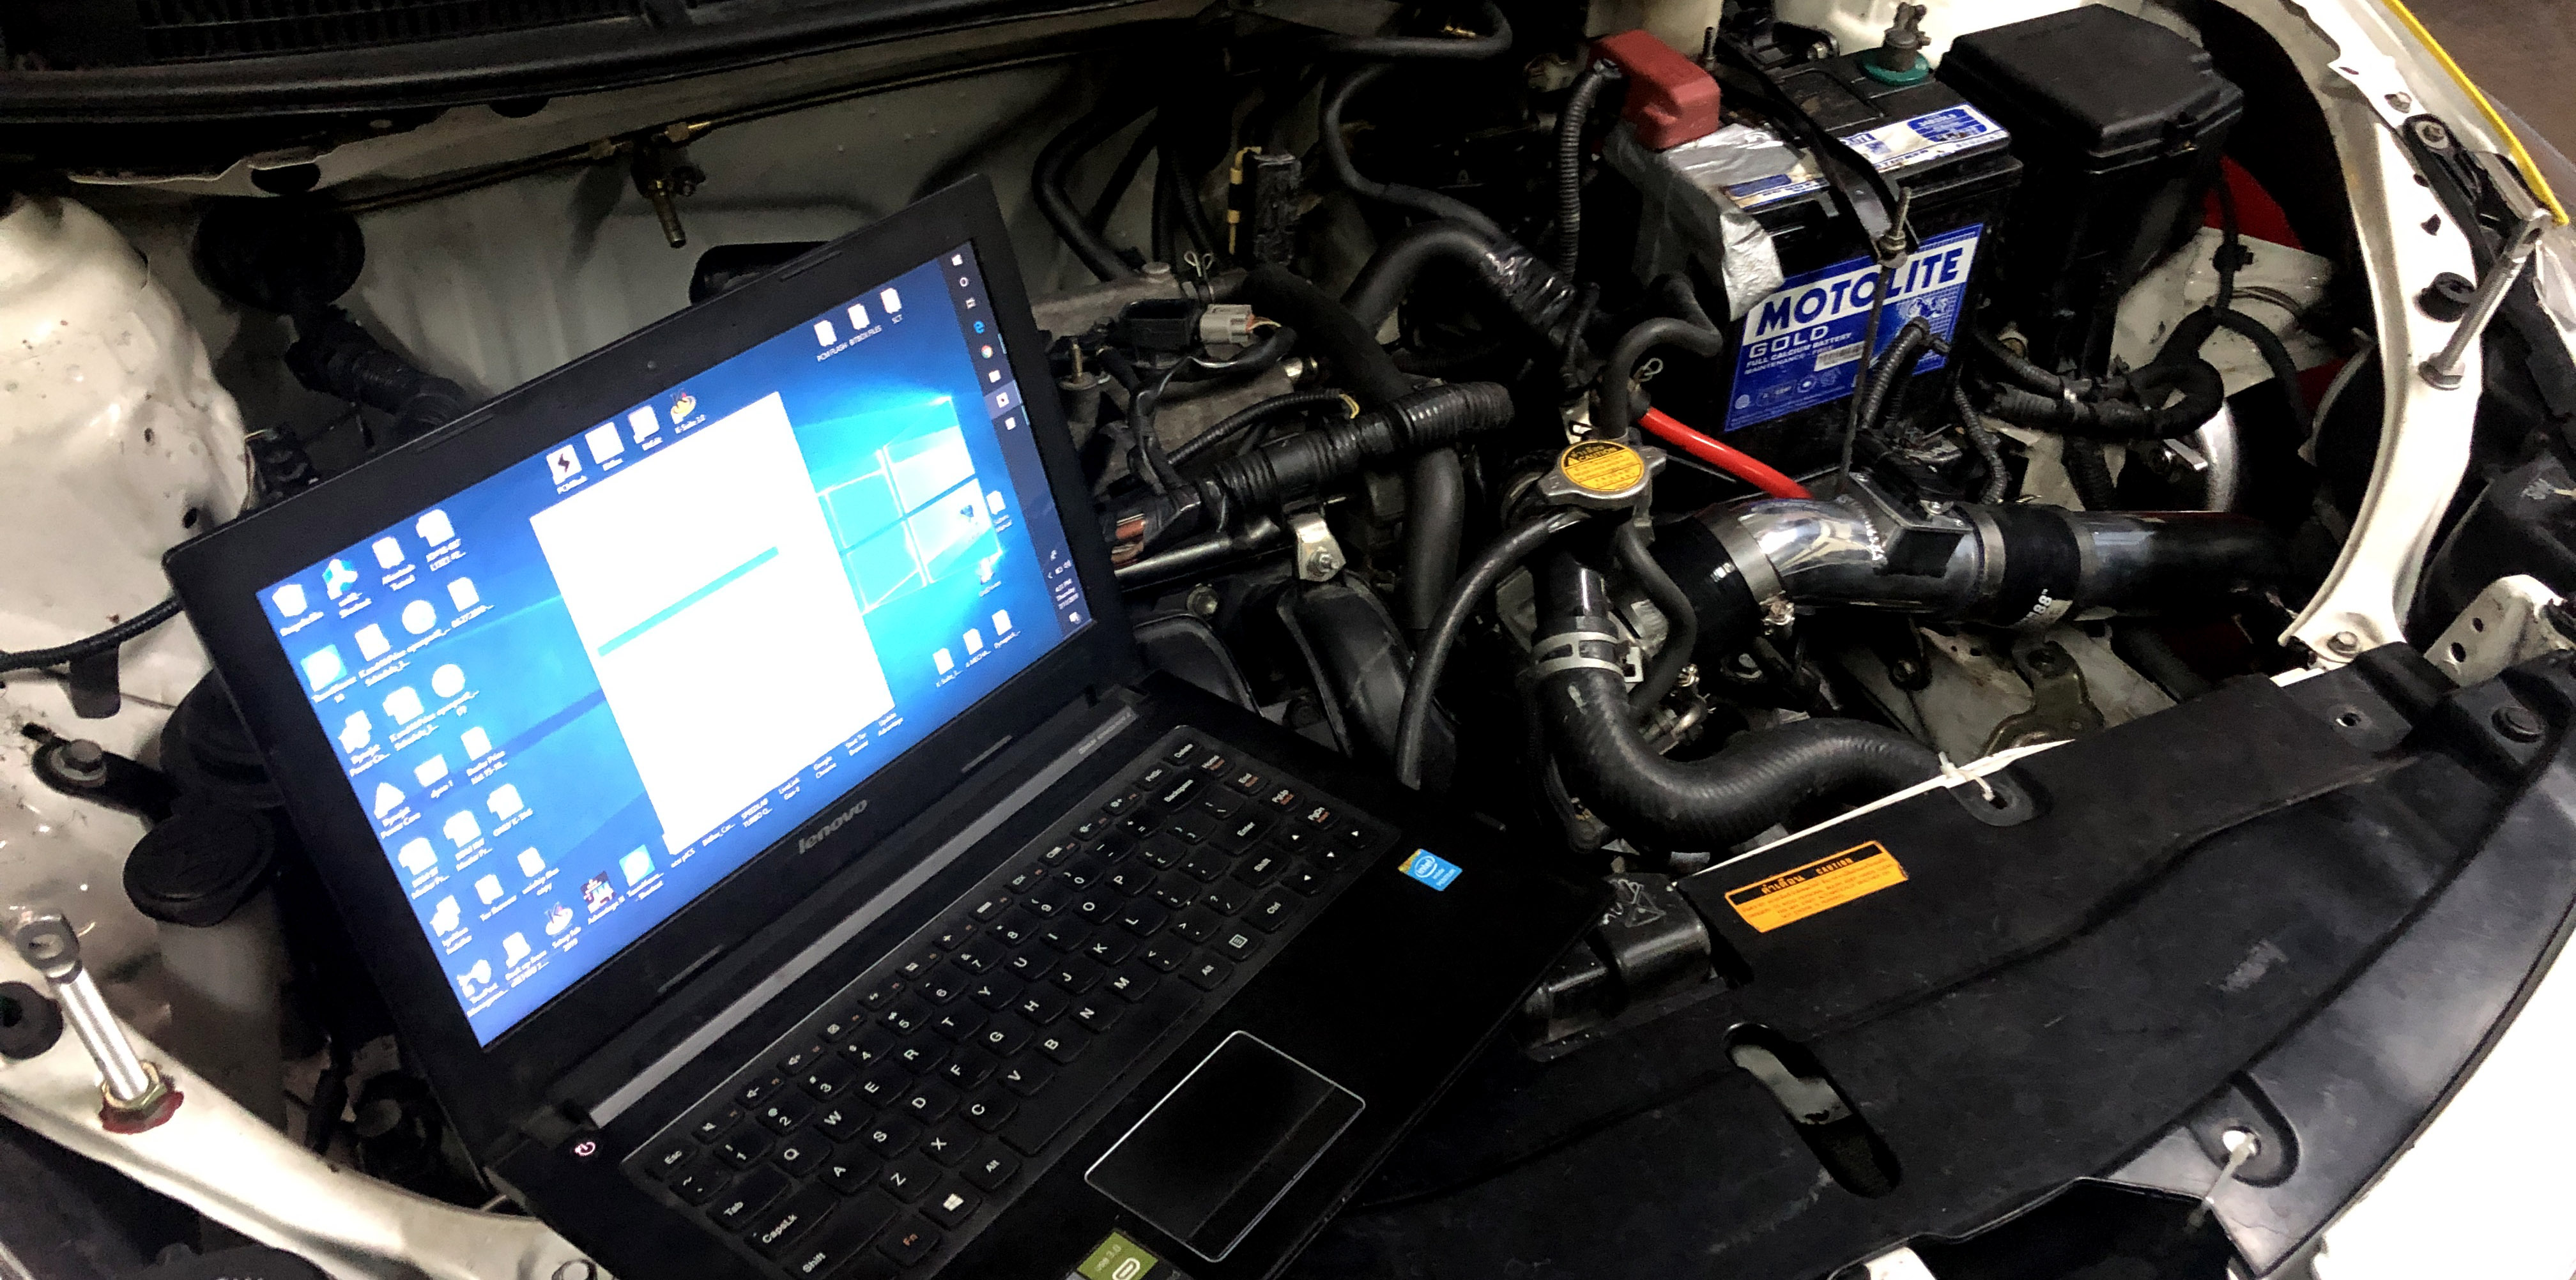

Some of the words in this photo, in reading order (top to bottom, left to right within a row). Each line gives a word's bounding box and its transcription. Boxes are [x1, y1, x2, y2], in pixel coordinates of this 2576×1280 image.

[1755, 247, 1963, 337] MOTOLITE
[1749, 325, 1829, 359] GOLD
[1747, 356, 1770, 369] FULL
[1770, 345, 1812, 362] CALCIUM
[1812, 332, 1852, 351] BATTERY
[1744, 354, 1807, 375] MAINTENANCE
[1578, 446, 1618, 462] CAUTION
[1174, 744, 1192, 758] Delete
[1165, 780, 1193, 802] Backspace
[799, 800, 869, 855] lenovo
[1238, 822, 1254, 835] Enter
[1254, 858, 1271, 871] Shift
[1815, 858, 1854, 876] CAUTION
[1114, 876, 1123, 884] P
[1083, 903, 1094, 911] O
[1267, 903, 1280, 913] Ctrl
[1093, 943, 1107, 952] K
[1015, 958, 1027, 966] U
[1202, 966, 1213, 975] Alt
[1063, 973, 1071, 981] J
[1114, 977, 1129, 988] M
[1025, 1001, 1039, 1011] H
[1080, 1008, 1094, 1018] N
[942, 1017, 953, 1026] T
[990, 1032, 1003, 1042] G
[1045, 1039, 1058, 1049] B
[904, 1049, 918, 1060] R
[951, 1065, 960, 1075] F
[1008, 1070, 1020, 1079] V
[865, 1082, 878, 1093] E
[912, 1098, 926, 1108] D
[972, 1104, 985, 1115] C
[779, 1116, 790, 1125] 2
[825, 1111, 841, 1124] W
[873, 1132, 886, 1141] S
[931, 1138, 946, 1150] X
[665, 1151, 682, 1164] Esc
[785, 1149, 799, 1159] Q
[986, 1161, 999, 1172] Alt
[834, 1168, 845, 1177] A
[891, 1173, 905, 1185] Z
[724, 1202, 743, 1215] Tab
[763, 1215, 797, 1242] CapsLk
[803, 1253, 825, 1272] Shift
